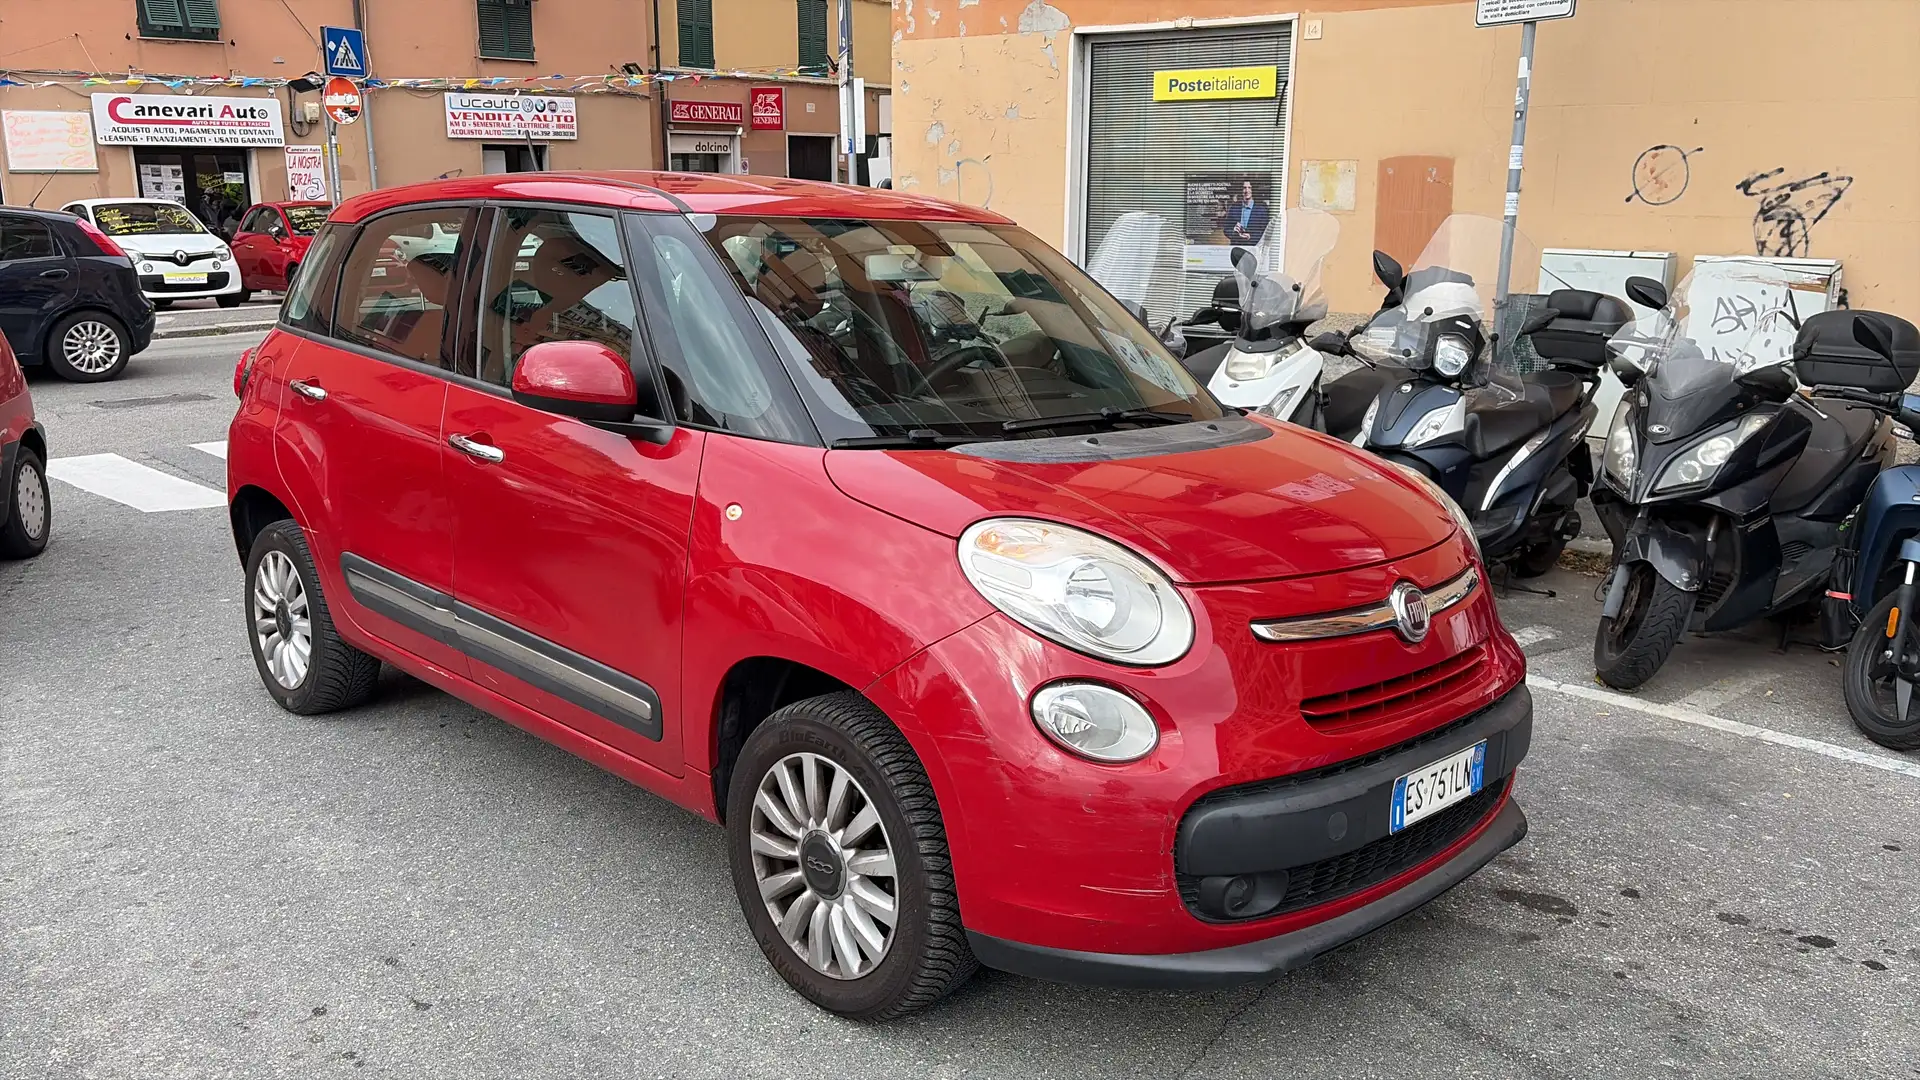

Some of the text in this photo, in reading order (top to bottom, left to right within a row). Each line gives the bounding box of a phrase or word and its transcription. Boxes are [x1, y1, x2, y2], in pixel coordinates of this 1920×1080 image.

[1168, 76, 1260, 92] Posteitaliane
[449, 96, 519, 110] Lucauto
[108, 97, 268, 124] Canevari Auto
[690, 105, 741, 120] GENERALI
[450, 112, 575, 123] VENDITA AUTO
[111, 126, 151, 134] ACQUISTO
[179, 127, 226, 135] PAGAMENTO
[695, 142, 729, 152] dolcino
[289, 156, 321, 169] LA NOSTRA
[291, 173, 312, 185] FORZA
[807, 855, 834, 874] 500
